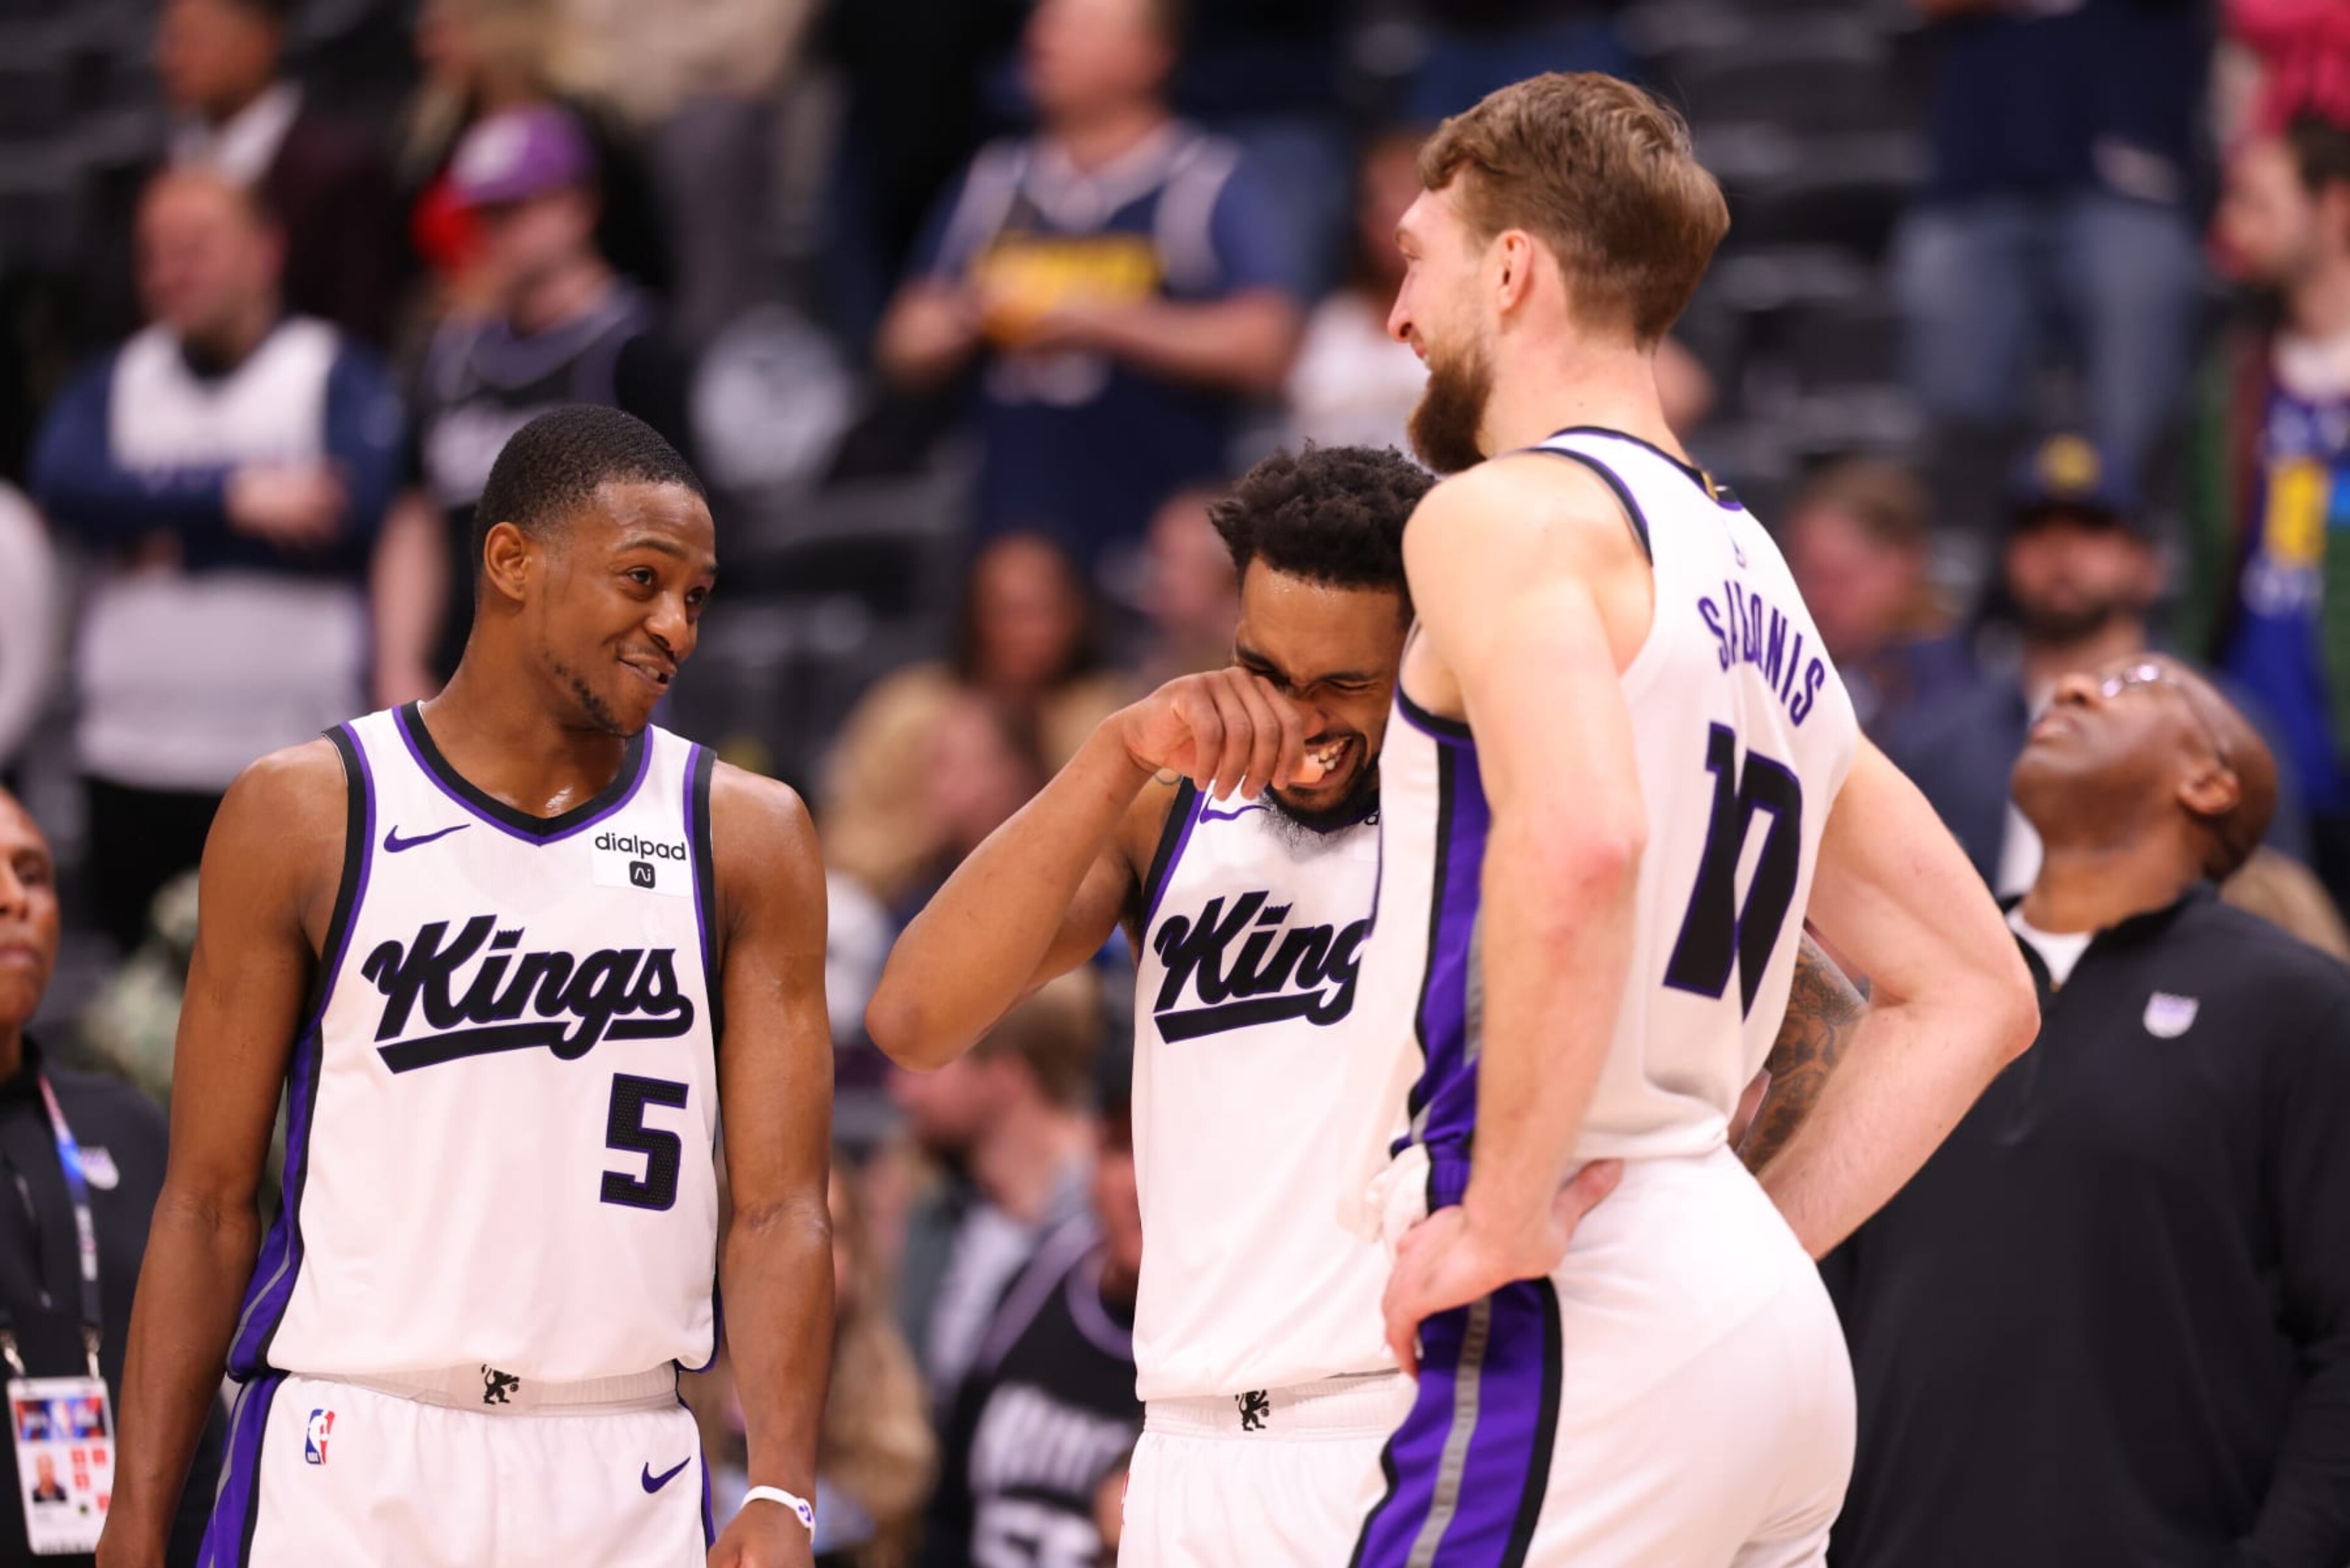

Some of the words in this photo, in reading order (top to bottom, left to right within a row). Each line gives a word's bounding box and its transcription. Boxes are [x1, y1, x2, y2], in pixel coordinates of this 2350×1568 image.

[595, 832, 686, 861] dialpad
[1663, 720, 1803, 1024] 10
[360, 914, 695, 1074] Kings
[1154, 890, 1373, 1044] King
[600, 1073, 689, 1211] 5
